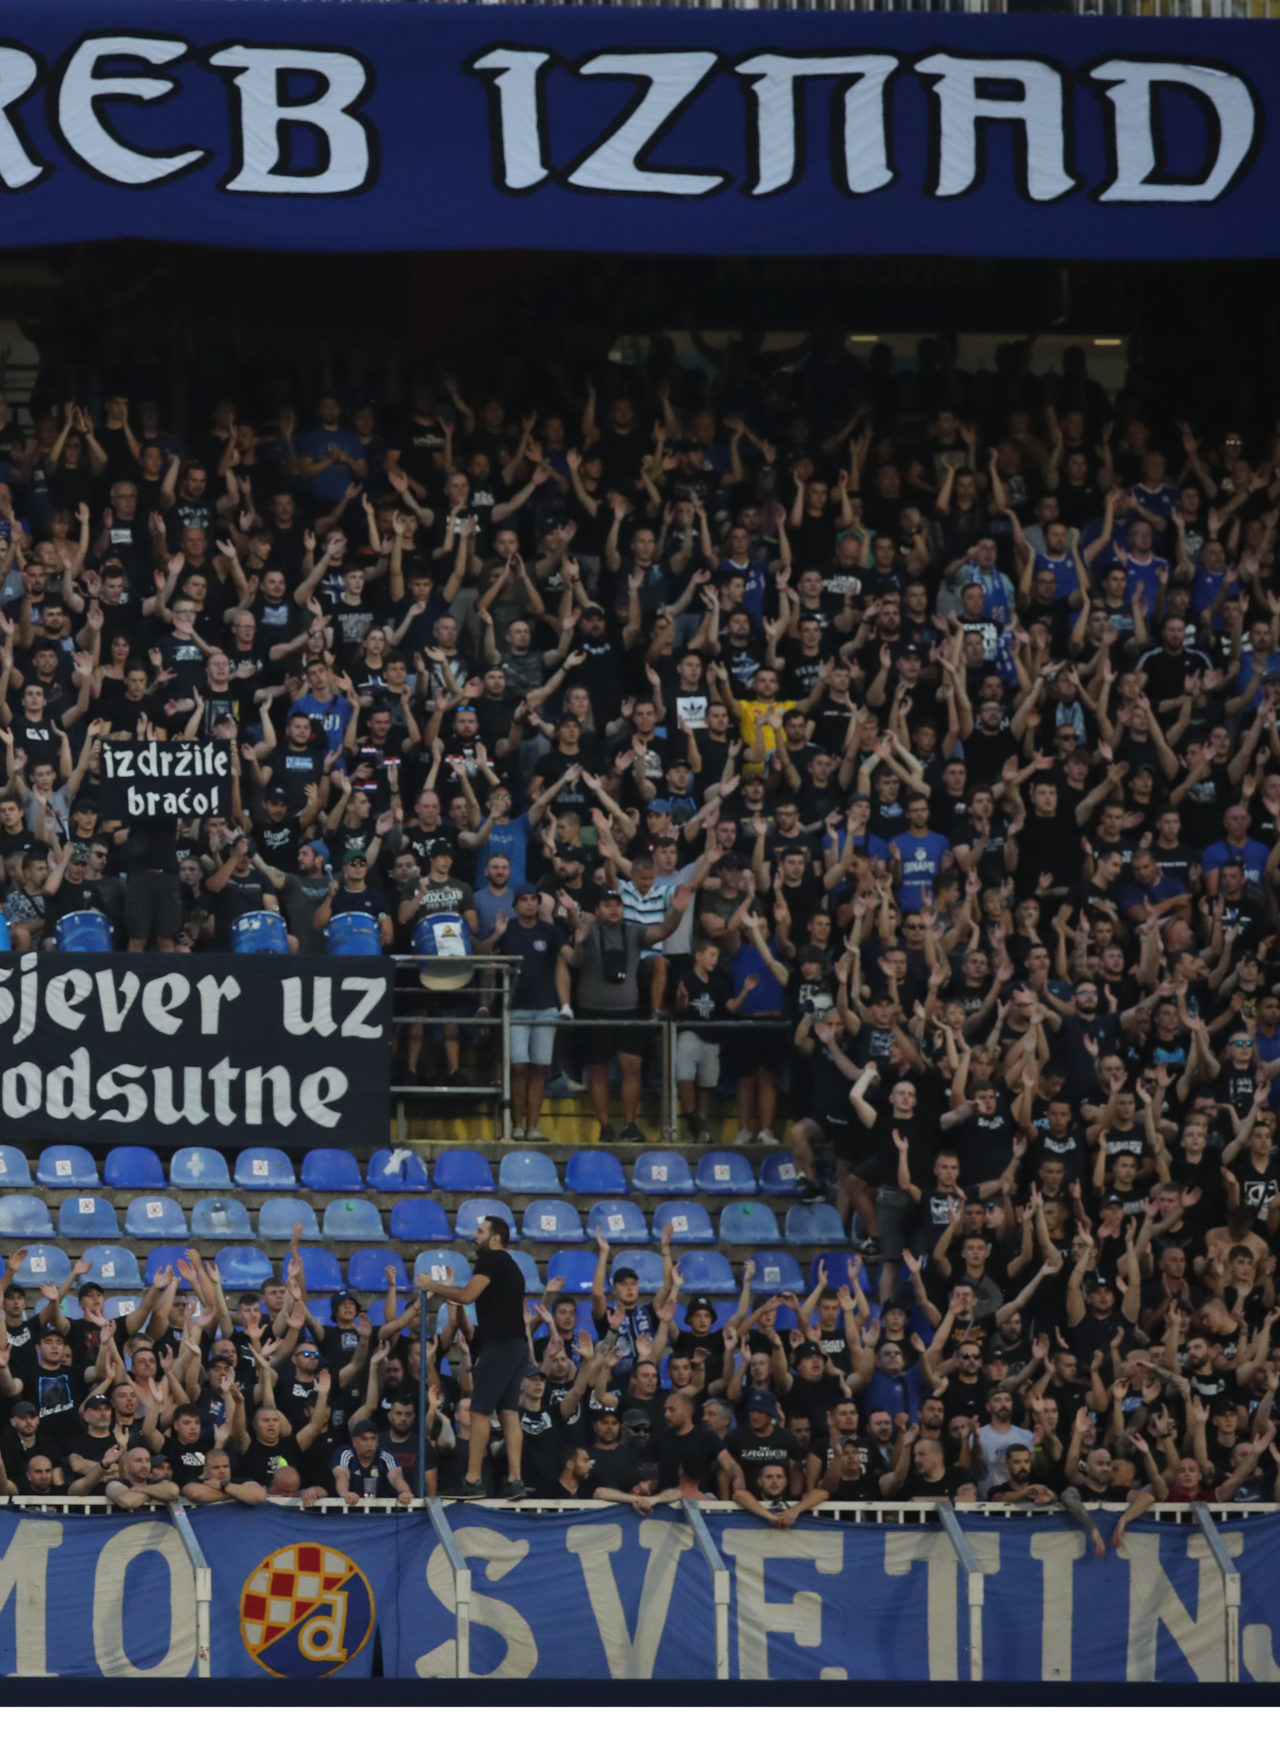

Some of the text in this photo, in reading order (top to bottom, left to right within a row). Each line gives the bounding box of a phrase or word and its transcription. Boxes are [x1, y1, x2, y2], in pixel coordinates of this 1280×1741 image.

[103, 740, 229, 779] izdržite
[127, 784, 220, 816] braćo!
[281, 975, 388, 1039] uz
[1, 1046, 349, 1129] odsutne
